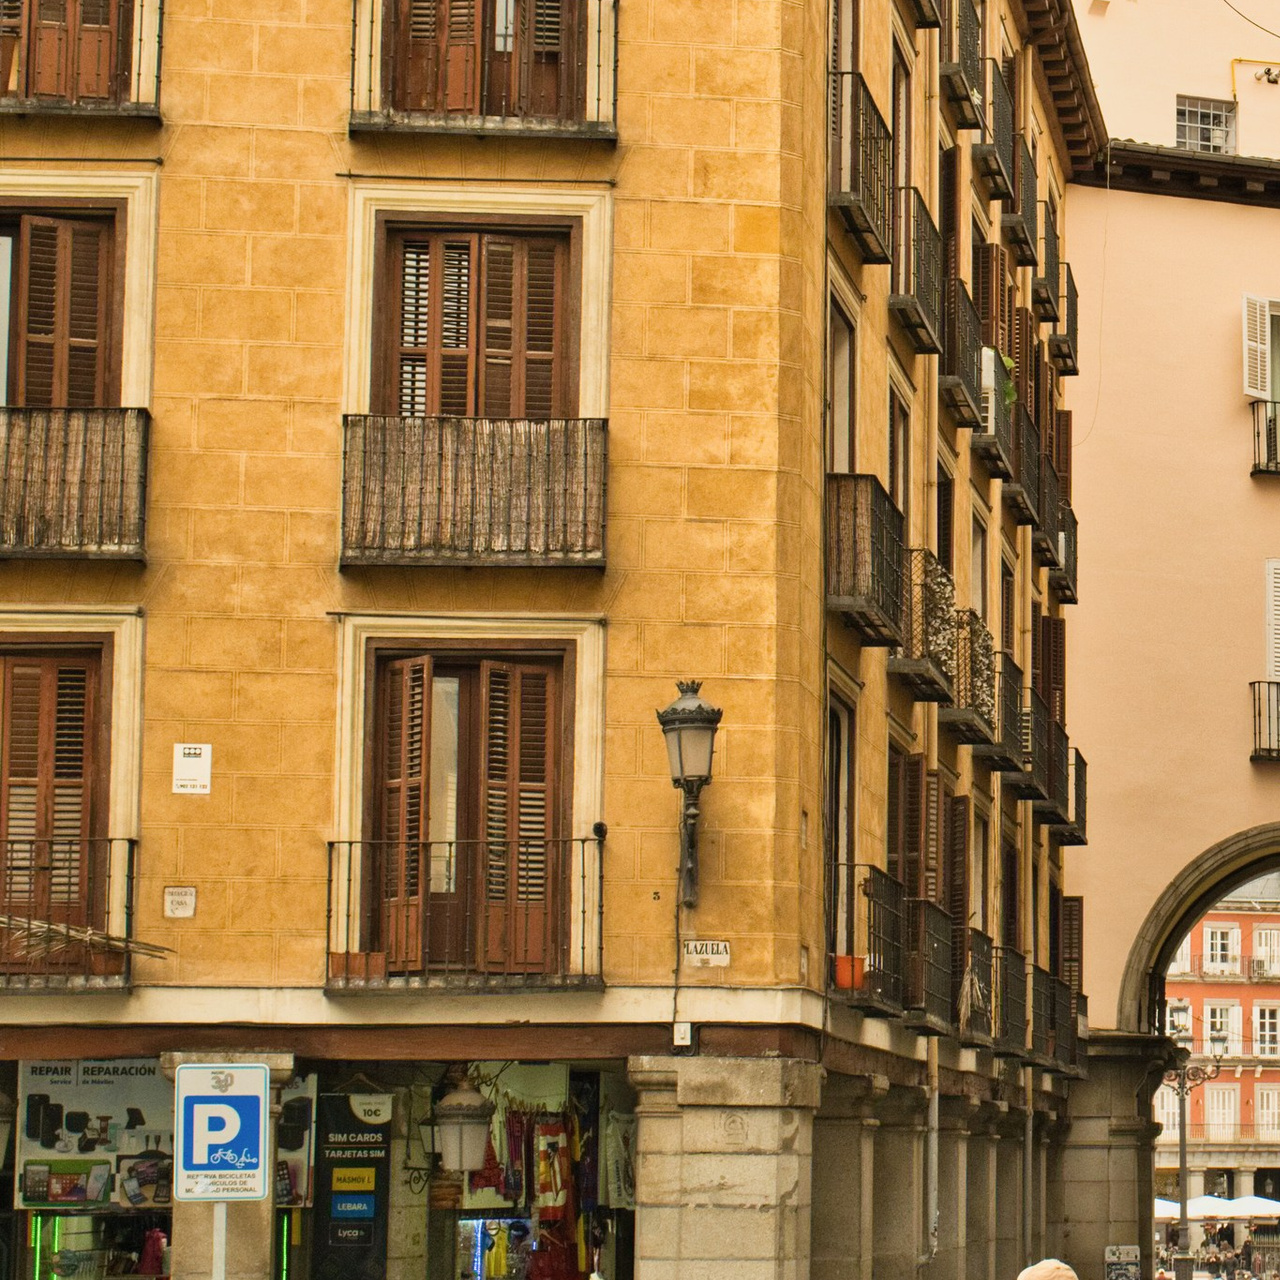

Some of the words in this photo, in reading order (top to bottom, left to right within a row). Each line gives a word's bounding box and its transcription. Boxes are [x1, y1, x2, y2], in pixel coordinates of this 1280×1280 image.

[30, 1066, 72, 1076] REPAIR
[82, 1063, 156, 1076] REPARACIÓN
[363, 1108, 381, 1117] 10€
[192, 1104, 241, 1165] P
[328, 1133, 347, 1142] SIM
[349, 1133, 383, 1142] CARDS
[325, 1150, 369, 1158] TARJETAS
[369, 1150, 385, 1158] SIM
[337, 1203, 368, 1211] LEBARA
[338, 1229, 359, 1238] Lyca
